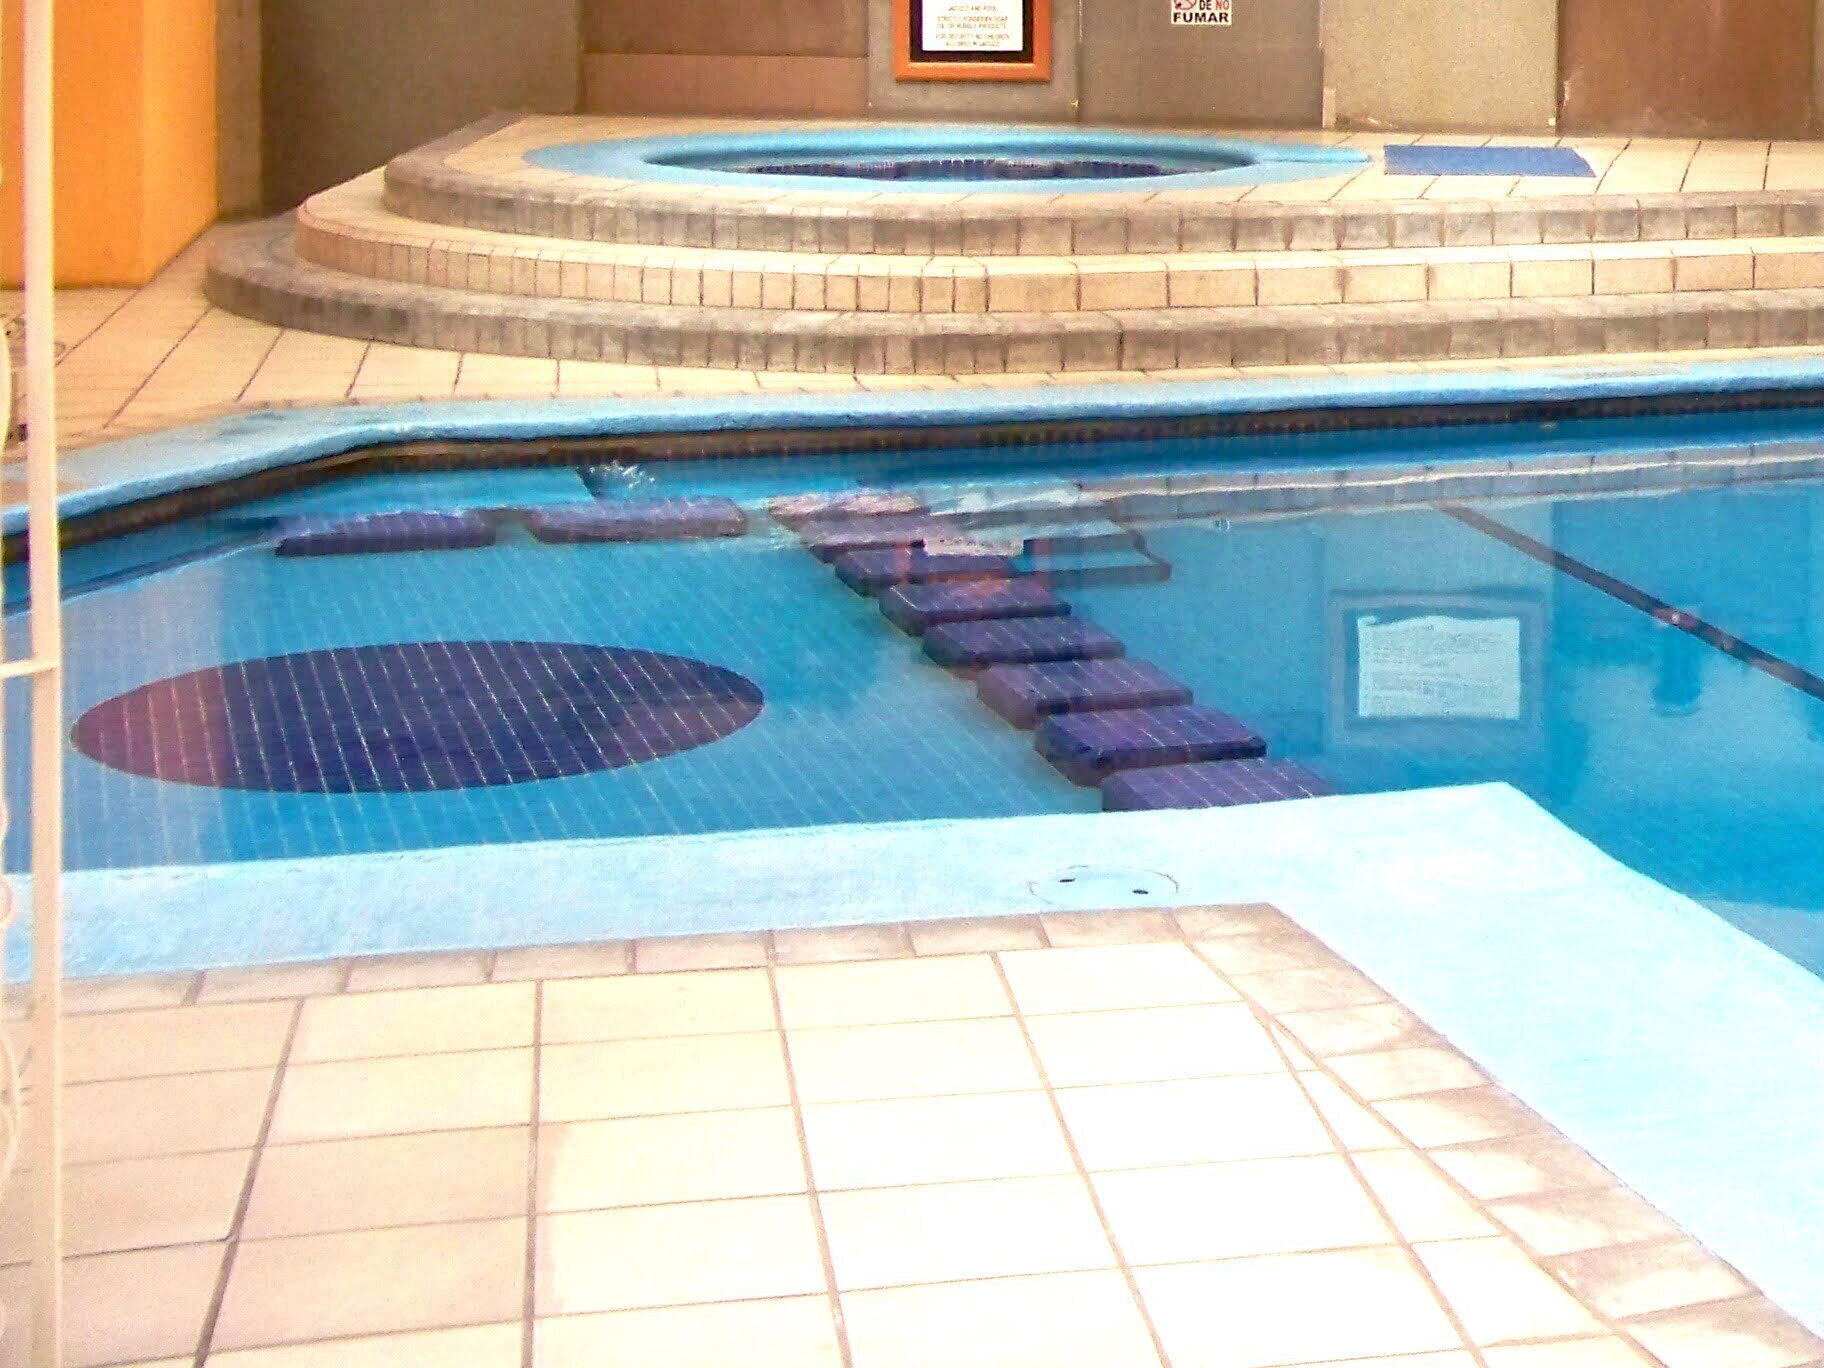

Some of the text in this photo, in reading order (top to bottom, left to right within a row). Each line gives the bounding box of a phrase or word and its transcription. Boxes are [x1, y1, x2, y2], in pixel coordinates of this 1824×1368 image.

[1200, 0, 1230, 10] DE NO
[1173, 12, 1229, 23] FUMAR
